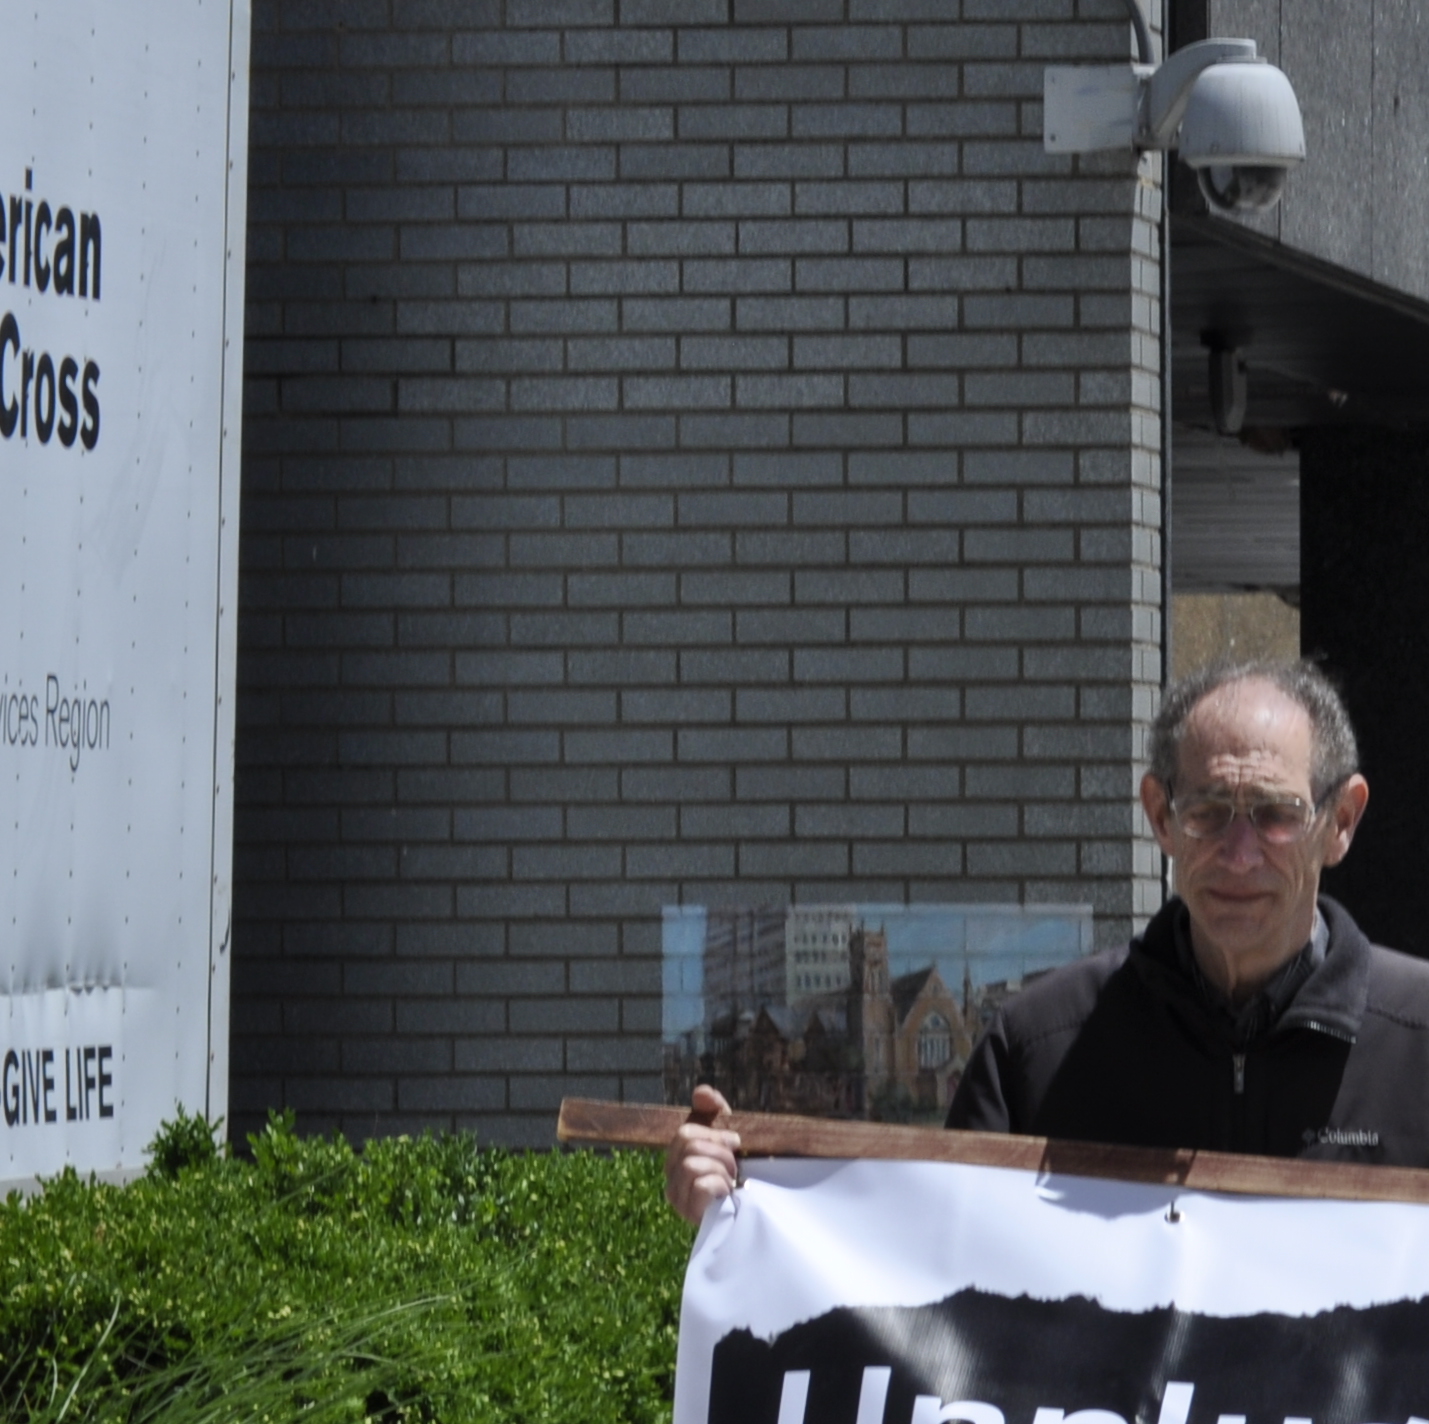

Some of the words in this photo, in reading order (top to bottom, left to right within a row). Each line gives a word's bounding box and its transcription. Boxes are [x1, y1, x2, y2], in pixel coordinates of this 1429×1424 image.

[0, 167, 101, 300] rican
[45, 673, 111, 773] Region
[2, 1048, 57, 1126] GIVE
[66, 1045, 114, 1122] LIFE
[1317, 1127, 1379, 1147] Columbia
